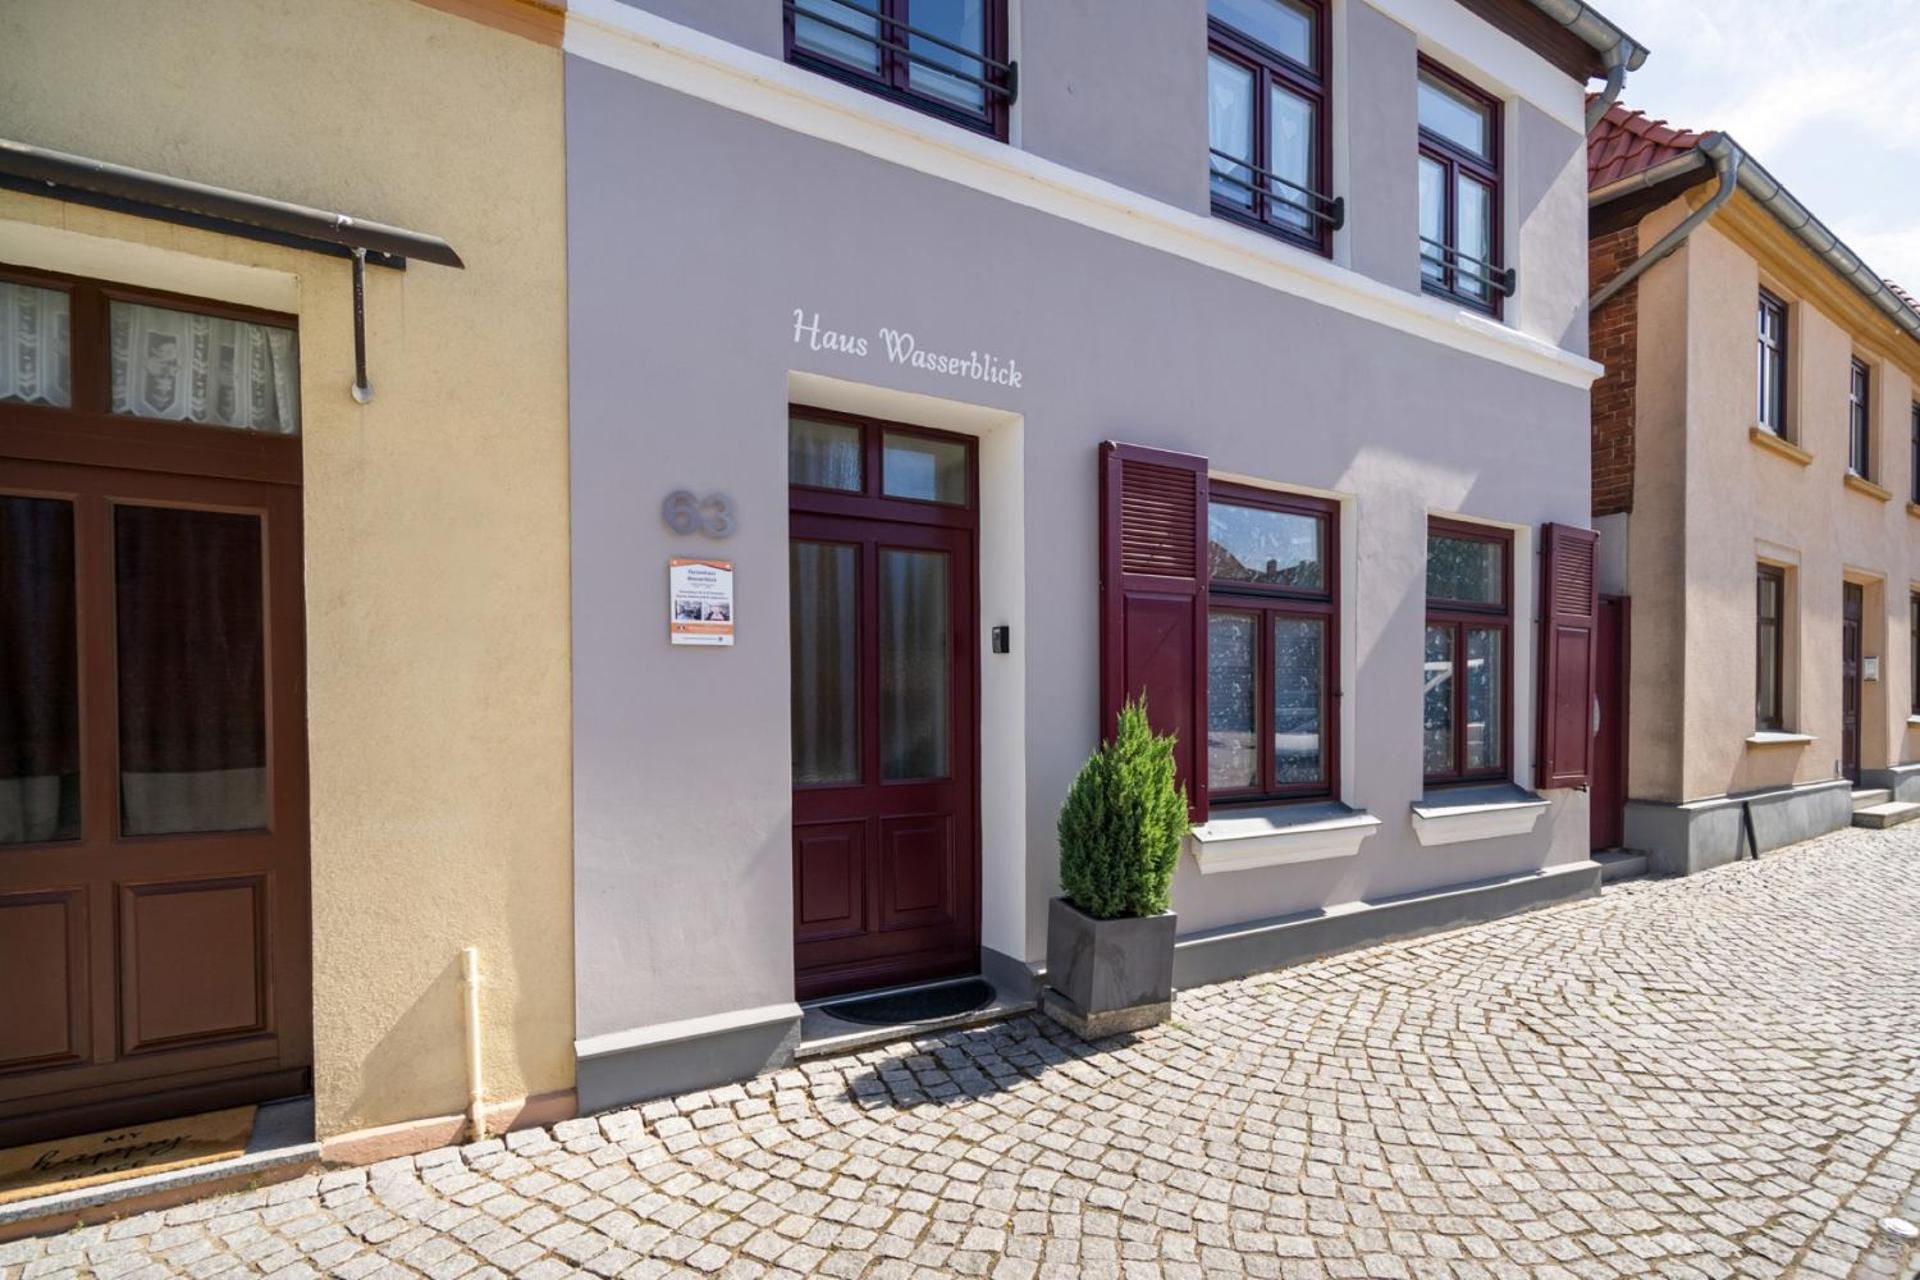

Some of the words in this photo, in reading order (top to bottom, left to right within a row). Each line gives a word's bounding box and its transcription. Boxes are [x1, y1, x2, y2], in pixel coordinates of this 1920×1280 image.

[793, 308, 868, 357] Haus
[879, 327, 1023, 388] Wasserblick
[661, 490, 737, 540] 63
